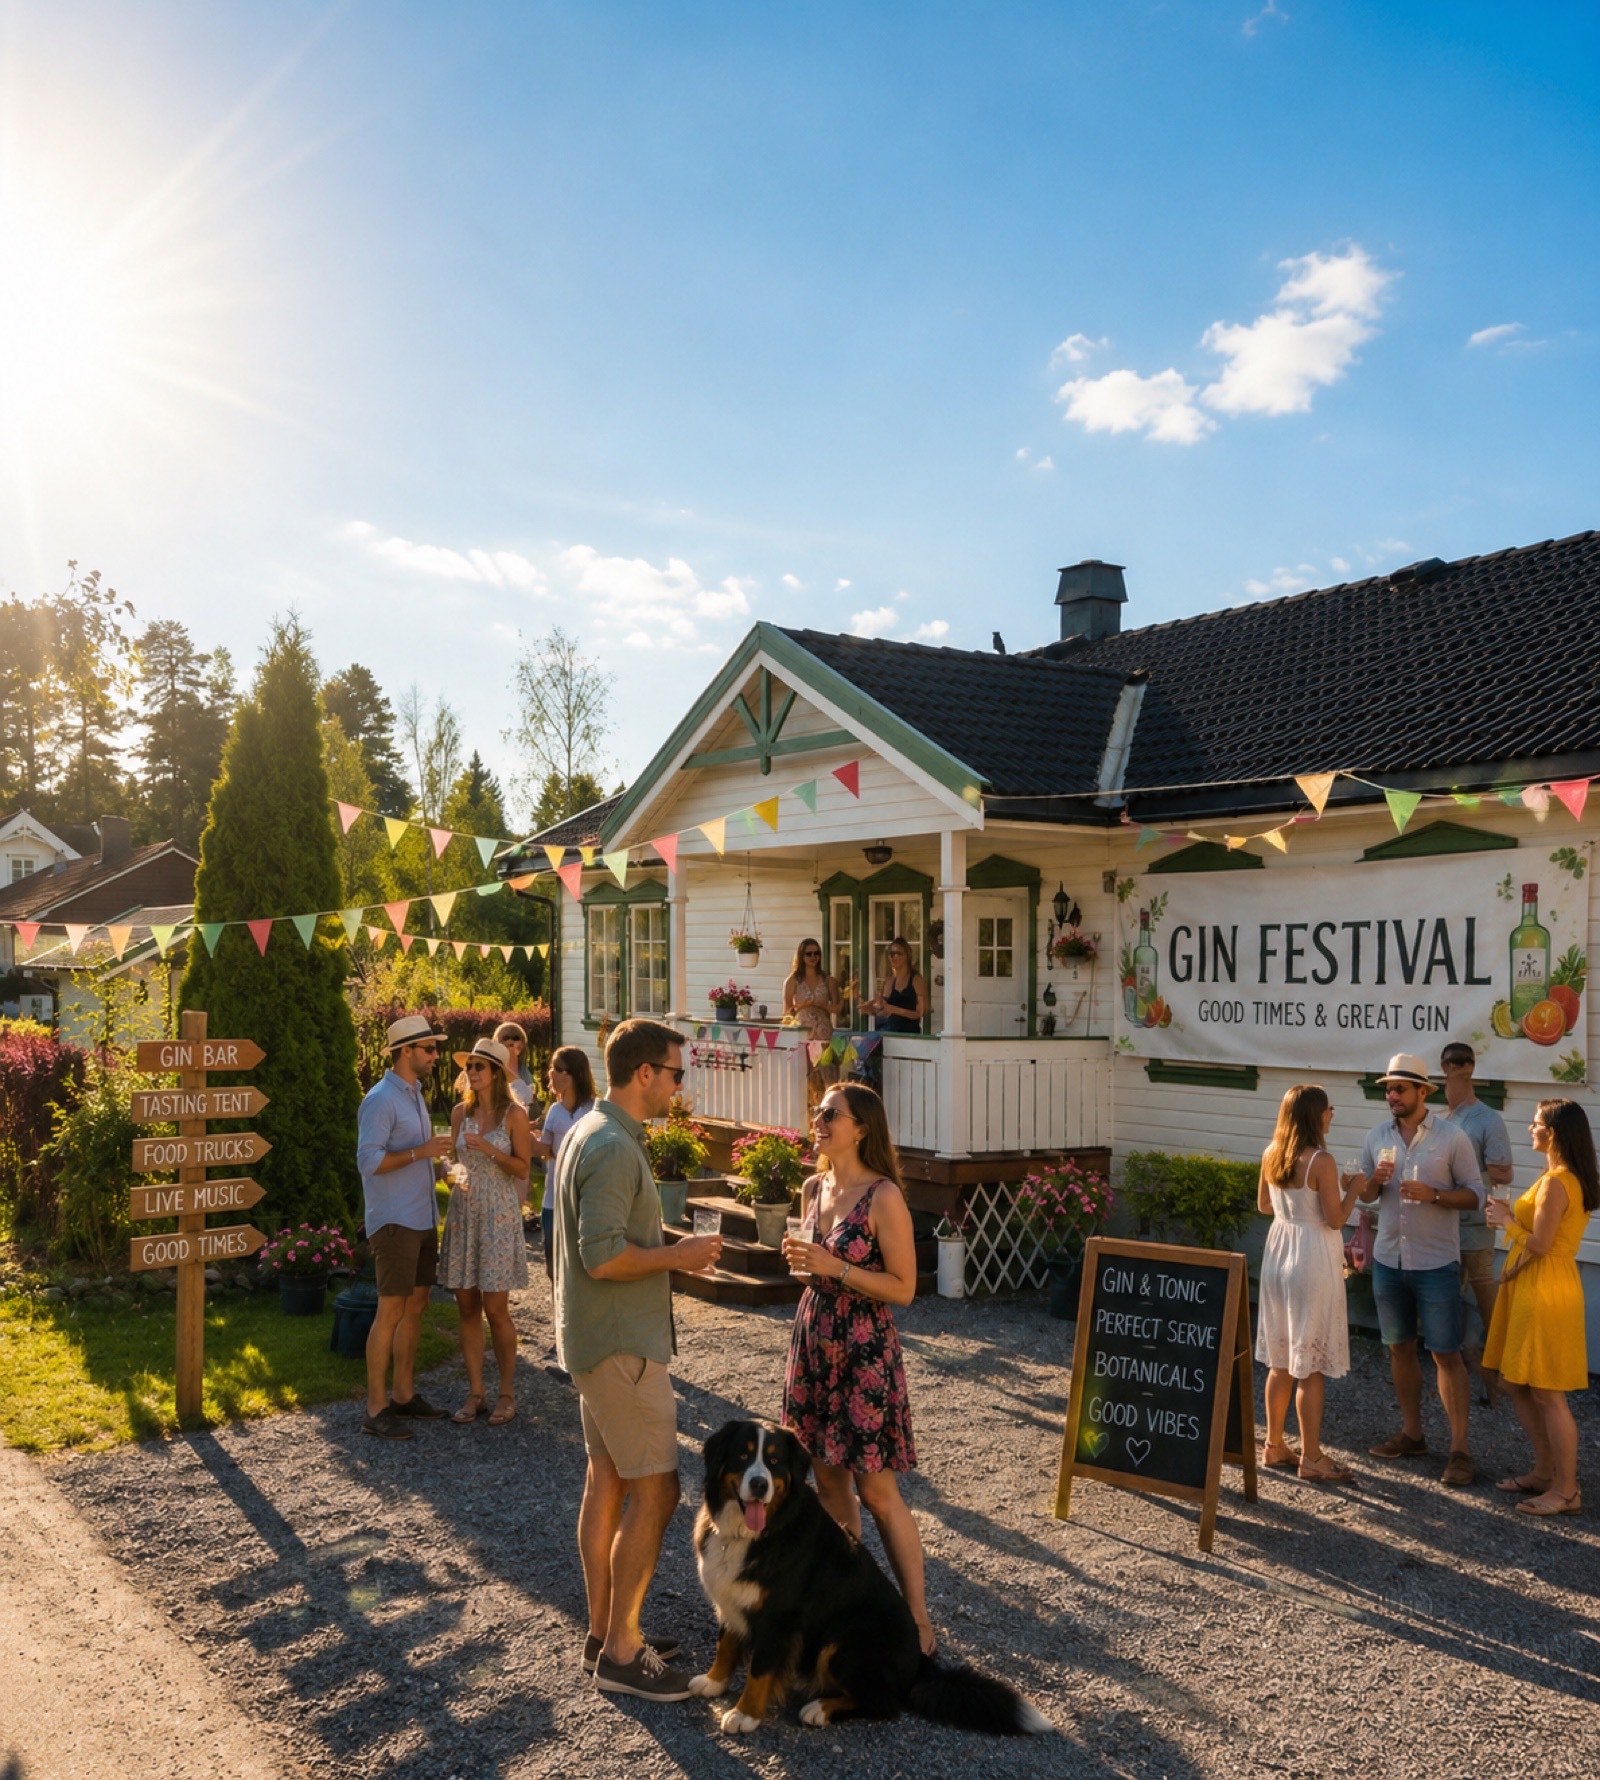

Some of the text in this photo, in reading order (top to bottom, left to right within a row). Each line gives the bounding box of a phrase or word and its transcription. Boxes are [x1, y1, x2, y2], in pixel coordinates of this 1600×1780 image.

[1168, 917, 1492, 986] GIN FESTIVAL
[1198, 1000, 1450, 1032] GOOD TIMES & GREAT GIN
[160, 1045, 238, 1068] GIN BAR
[140, 1092, 252, 1117] TASTING TENT
[144, 1139, 254, 1165] FOOD TRUCKS
[144, 1184, 244, 1213] LIVE MUSIC
[143, 1232, 247, 1264] GOOD TIMES
[1102, 1267, 1207, 1304] GIN & TONIC
[1096, 1309, 1217, 1350] PERFECT SERVE
[1094, 1351, 1205, 1393] BOTANICALS
[1089, 1397, 1200, 1440] GOOD VIBES
